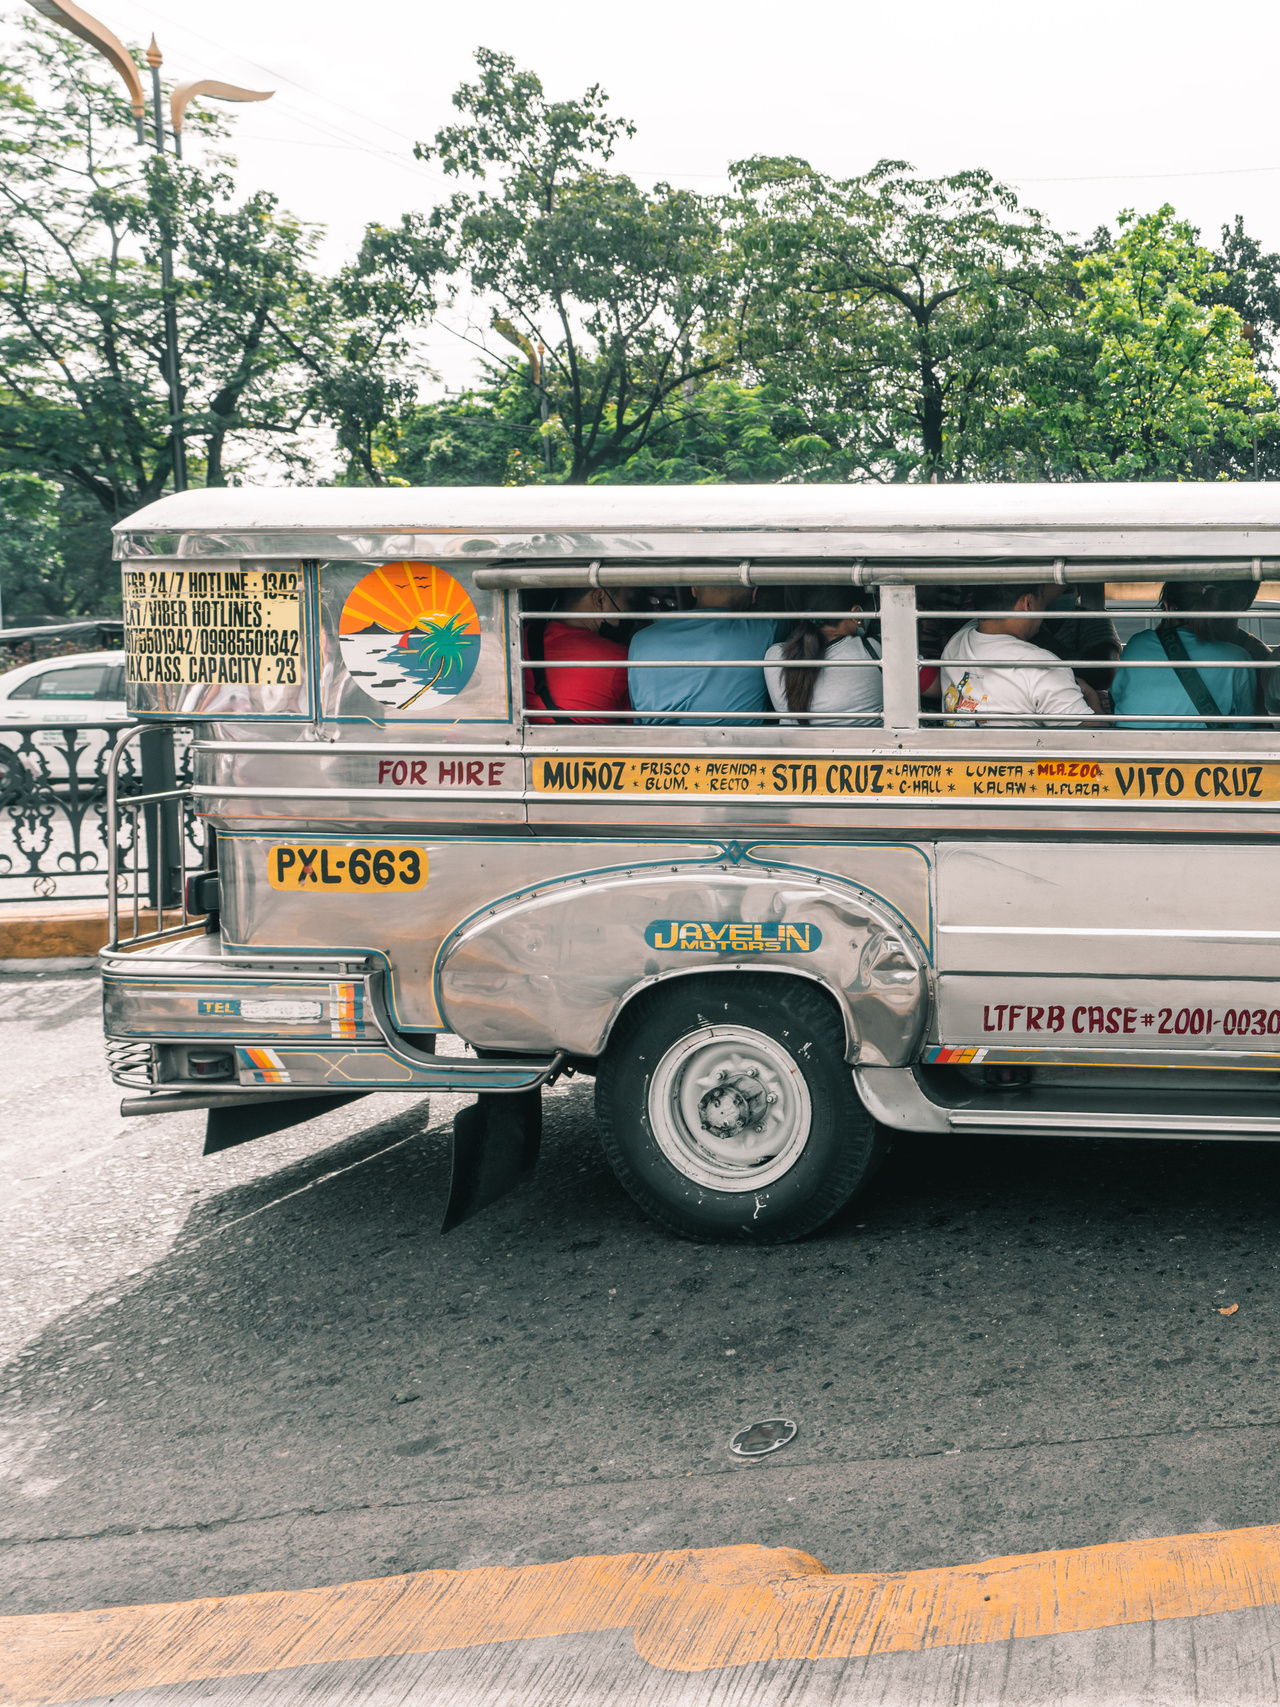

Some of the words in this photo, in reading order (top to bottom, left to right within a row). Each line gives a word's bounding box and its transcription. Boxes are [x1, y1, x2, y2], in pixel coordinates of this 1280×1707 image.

[149, 571, 185, 599] 24/7
[188, 572, 249, 600] HOTLINE
[261, 572, 299, 601] 1342
[124, 599, 188, 628] EXT/VIBER
[191, 601, 263, 629] HOTLINES
[125, 655, 185, 683] AX.PASS.
[188, 656, 262, 684] CAPACITY
[275, 657, 297, 684] 23
[377, 760, 429, 786] FOR
[438, 760, 506, 787] HIRE
[542, 760, 626, 792] MUÑOZ
[640, 762, 691, 776] FRISCO
[705, 762, 758, 777] AVENIDA
[645, 777, 689, 791] BLUM.
[708, 778, 750, 791] RECTO
[771, 763, 817, 793] STA
[825, 764, 885, 794] CRUZ
[894, 764, 942, 777] LAWTON
[965, 765, 1023, 778] LUNETA
[1114, 766, 1185, 797] VITO
[1194, 766, 1264, 798] CRUZ
[898, 780, 943, 794] C-HALL
[973, 781, 1027, 795] KALAW
[276, 848, 422, 885] PXL-663
[654, 922, 810, 951] JAVELIN
[680, 940, 782, 952] MOTORS
[202, 1001, 236, 1014] TEL
[983, 1004, 1066, 1033] LTFRB
